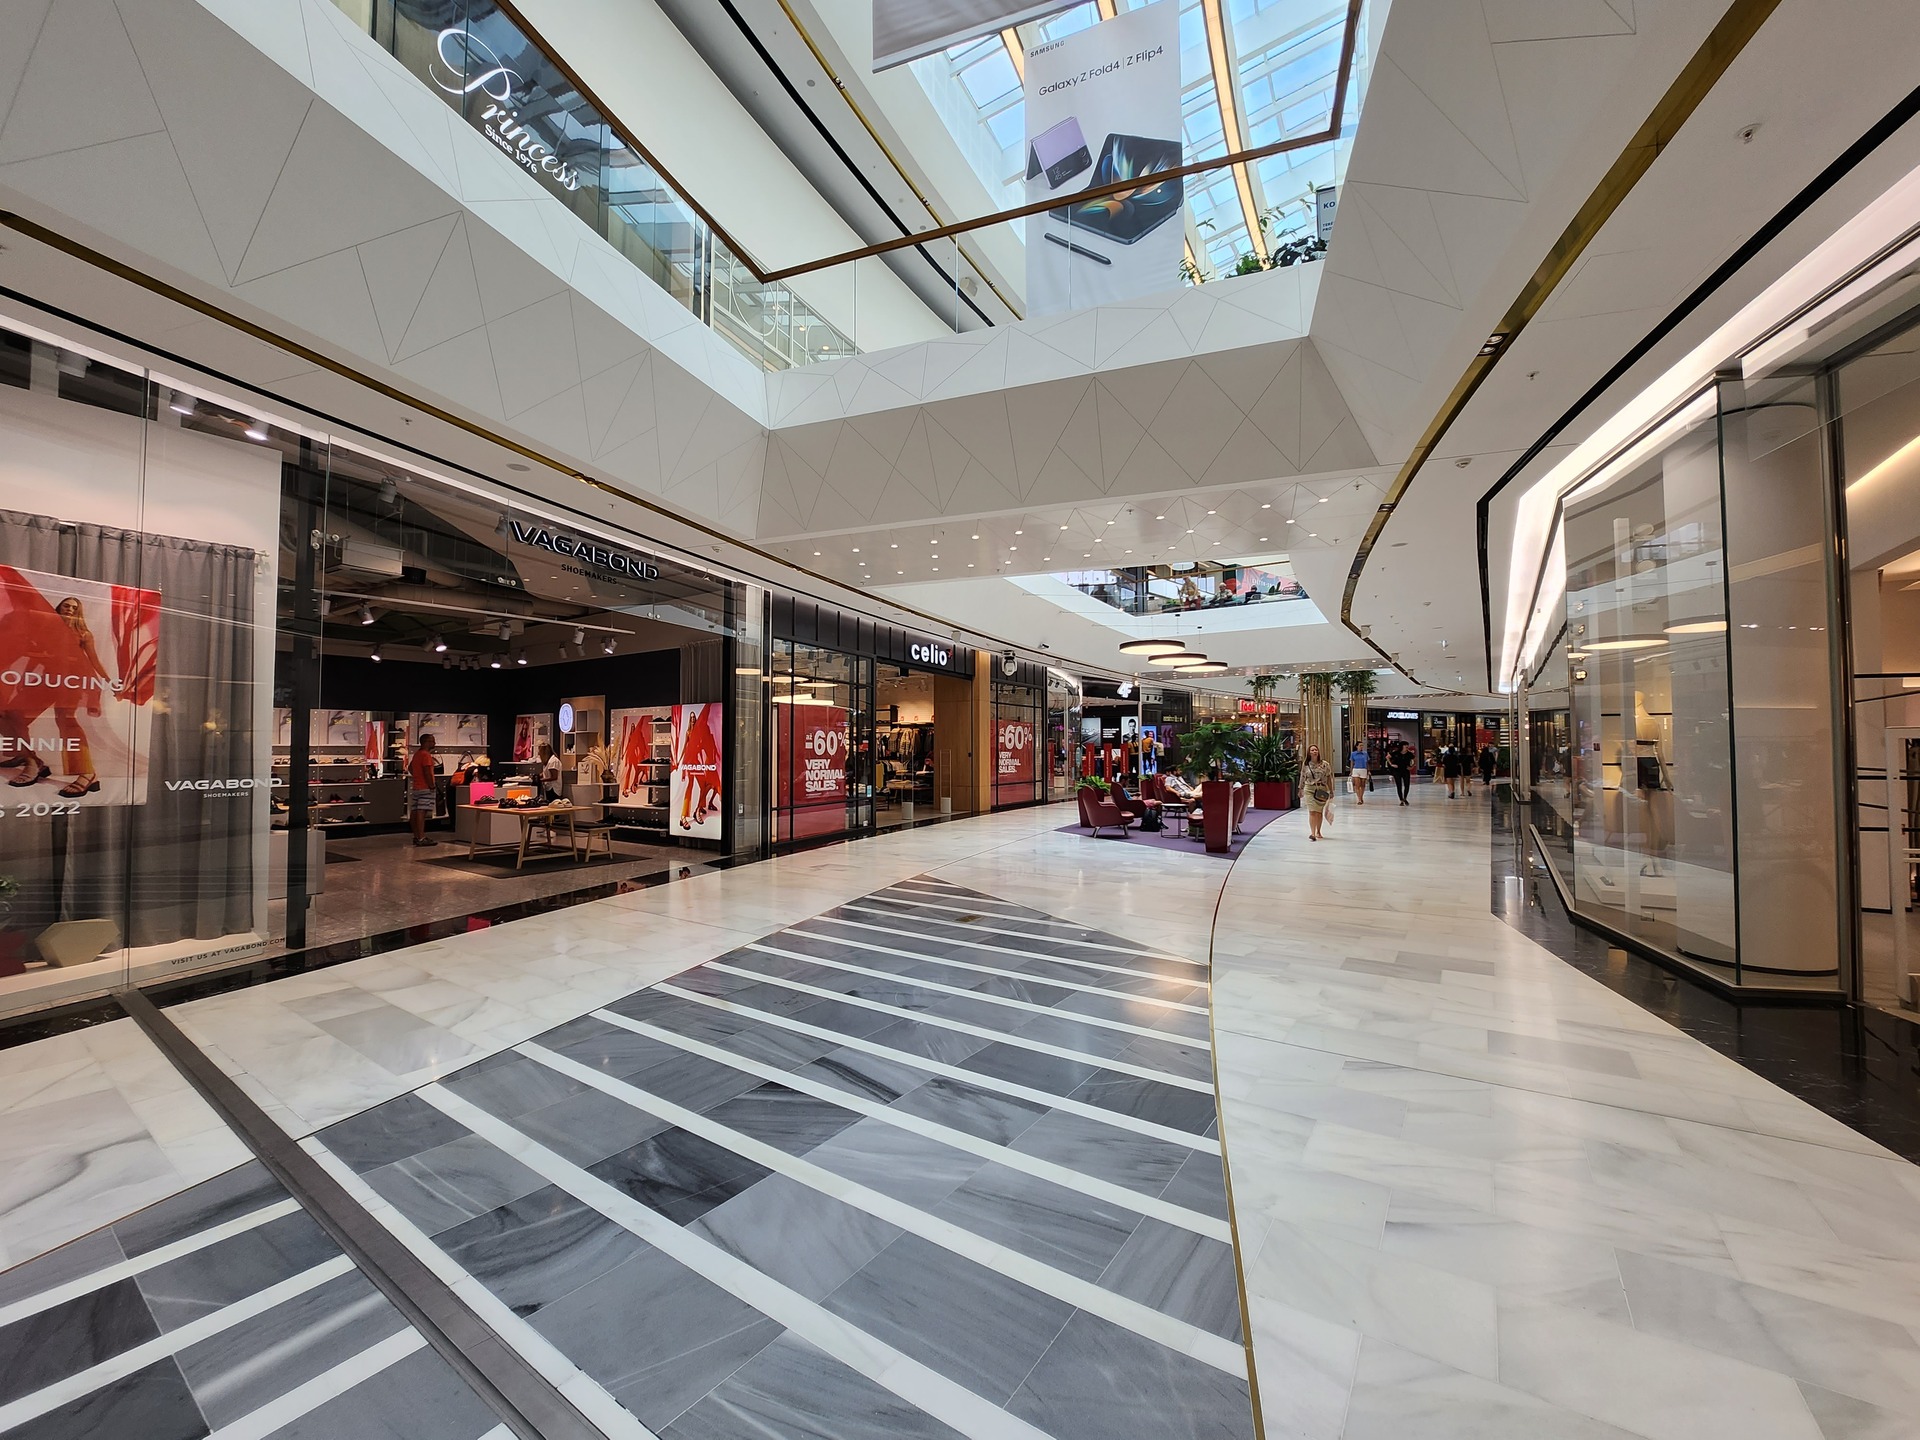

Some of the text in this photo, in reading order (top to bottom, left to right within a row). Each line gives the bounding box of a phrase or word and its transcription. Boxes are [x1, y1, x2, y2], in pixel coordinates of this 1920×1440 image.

[1030, 40, 1065, 58] SAMSUNG
[1038, 45, 1164, 96] Galaxy Z Fold4 Z Flip4
[428, 28, 580, 191] Princess
[484, 123, 538, 174] Since 1976
[509, 520, 660, 581] VAGABOND
[561, 563, 617, 585] SHOEMAKERS
[911, 643, 948, 666] celio
[1117, 681, 1133, 698] 4F
[805, 759, 831, 770] VERY
[805, 769, 845, 781] NORMAL
[164, 778, 283, 791] VAGABOND
[805, 780, 839, 793] SALES.
[203, 791, 249, 799] SHOEMAKERS
[15, 800, 81, 818] 2022
[171, 956, 194, 965] VISIT
[197, 953, 208, 961] US
[224, 937, 286, 954] VAGABOND.COM
